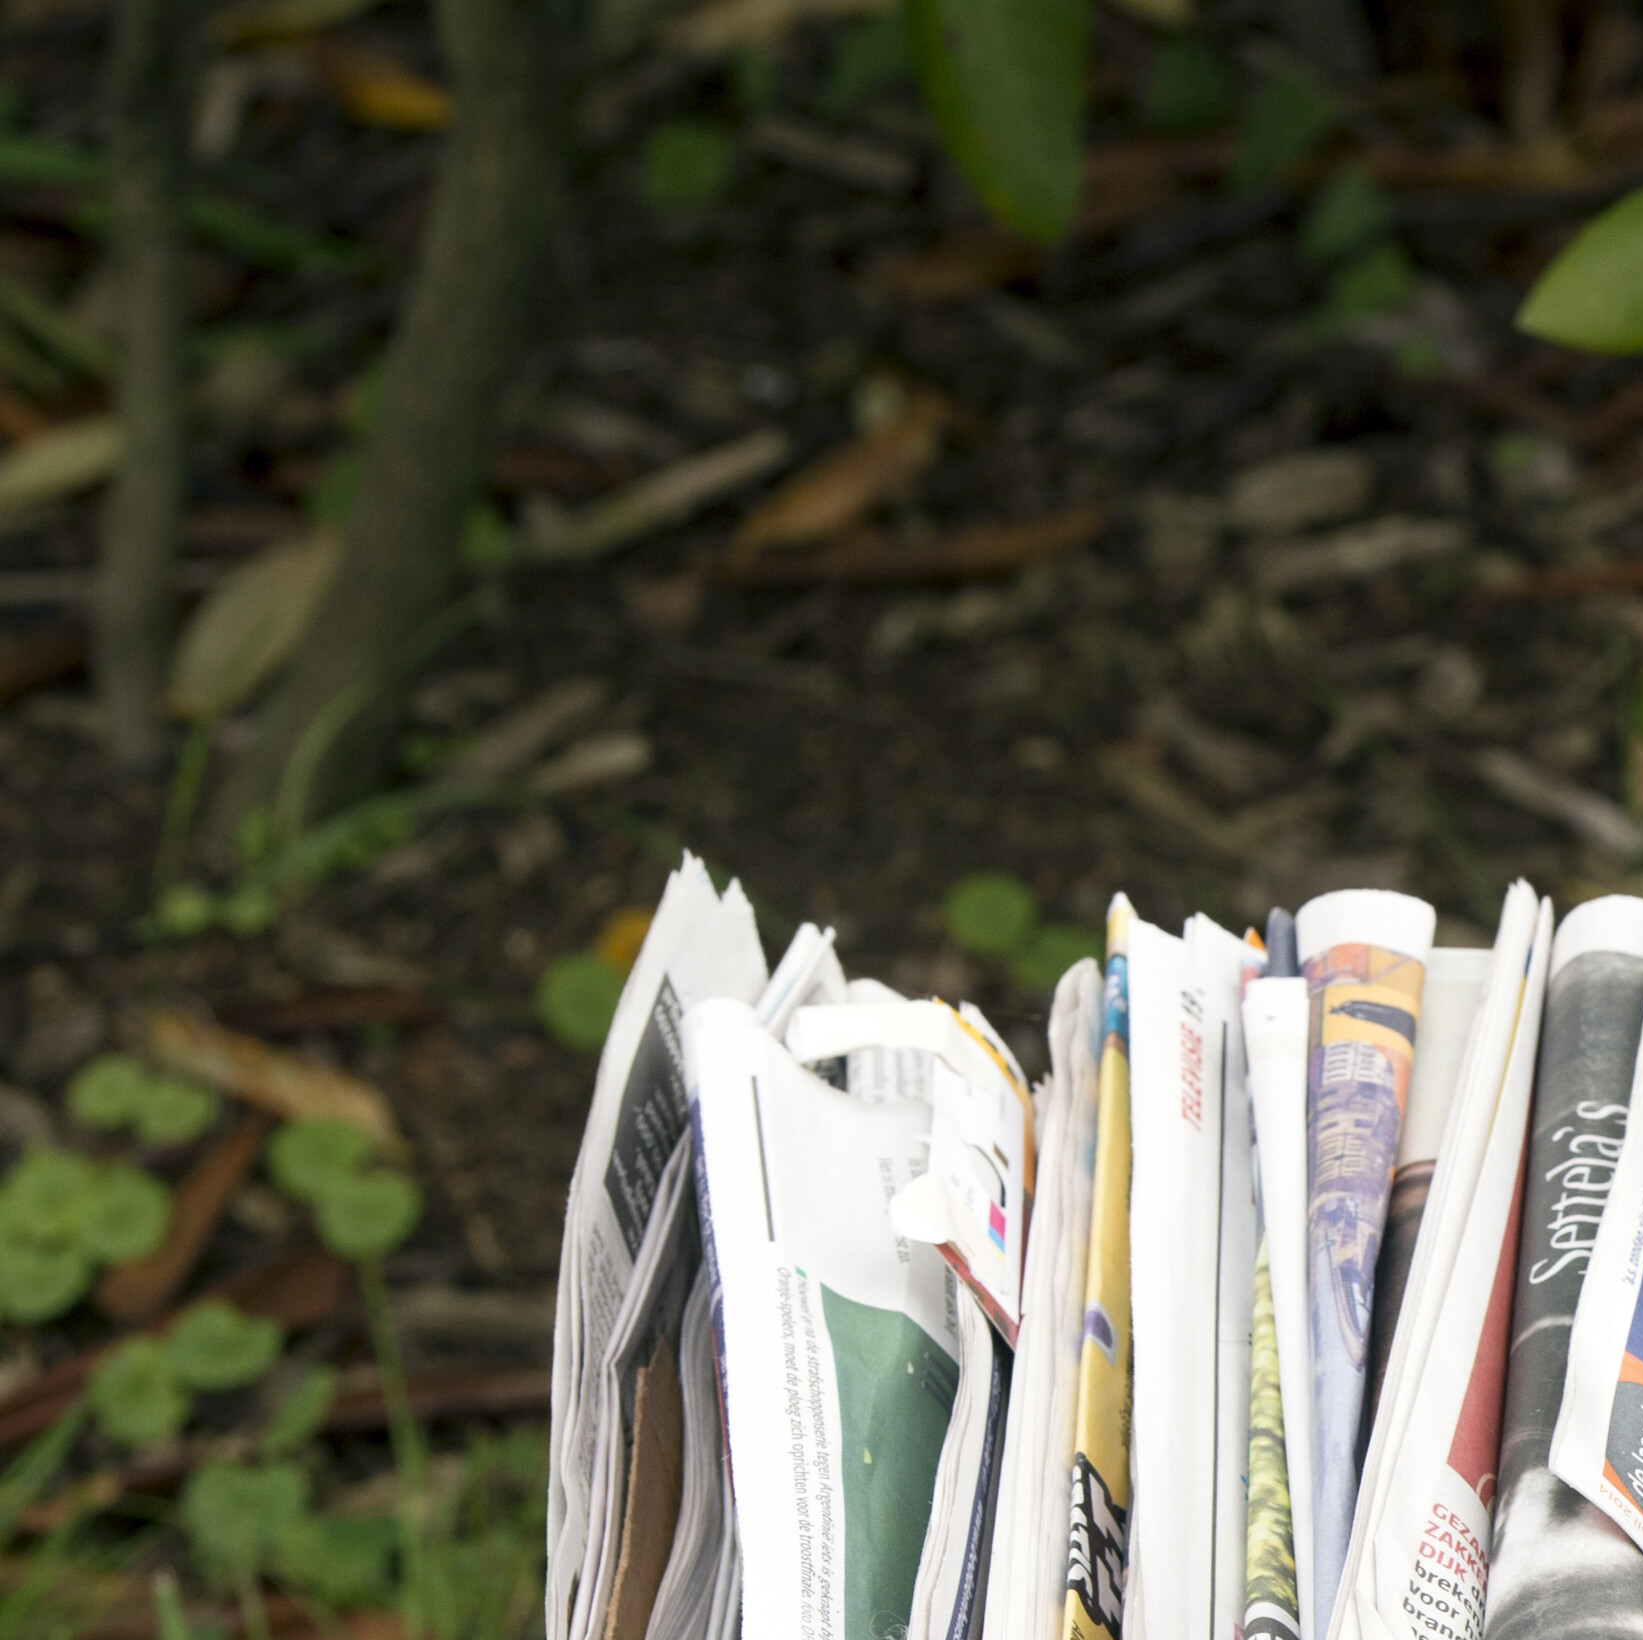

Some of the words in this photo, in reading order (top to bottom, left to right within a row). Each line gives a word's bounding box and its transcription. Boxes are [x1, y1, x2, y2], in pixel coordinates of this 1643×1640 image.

[1179, 1021, 1202, 1131] TELEVISIE
[1418, 1540, 1467, 1583] DIJK
[1409, 1578, 1460, 1620] voor
[1413, 1560, 1481, 1623] breken
